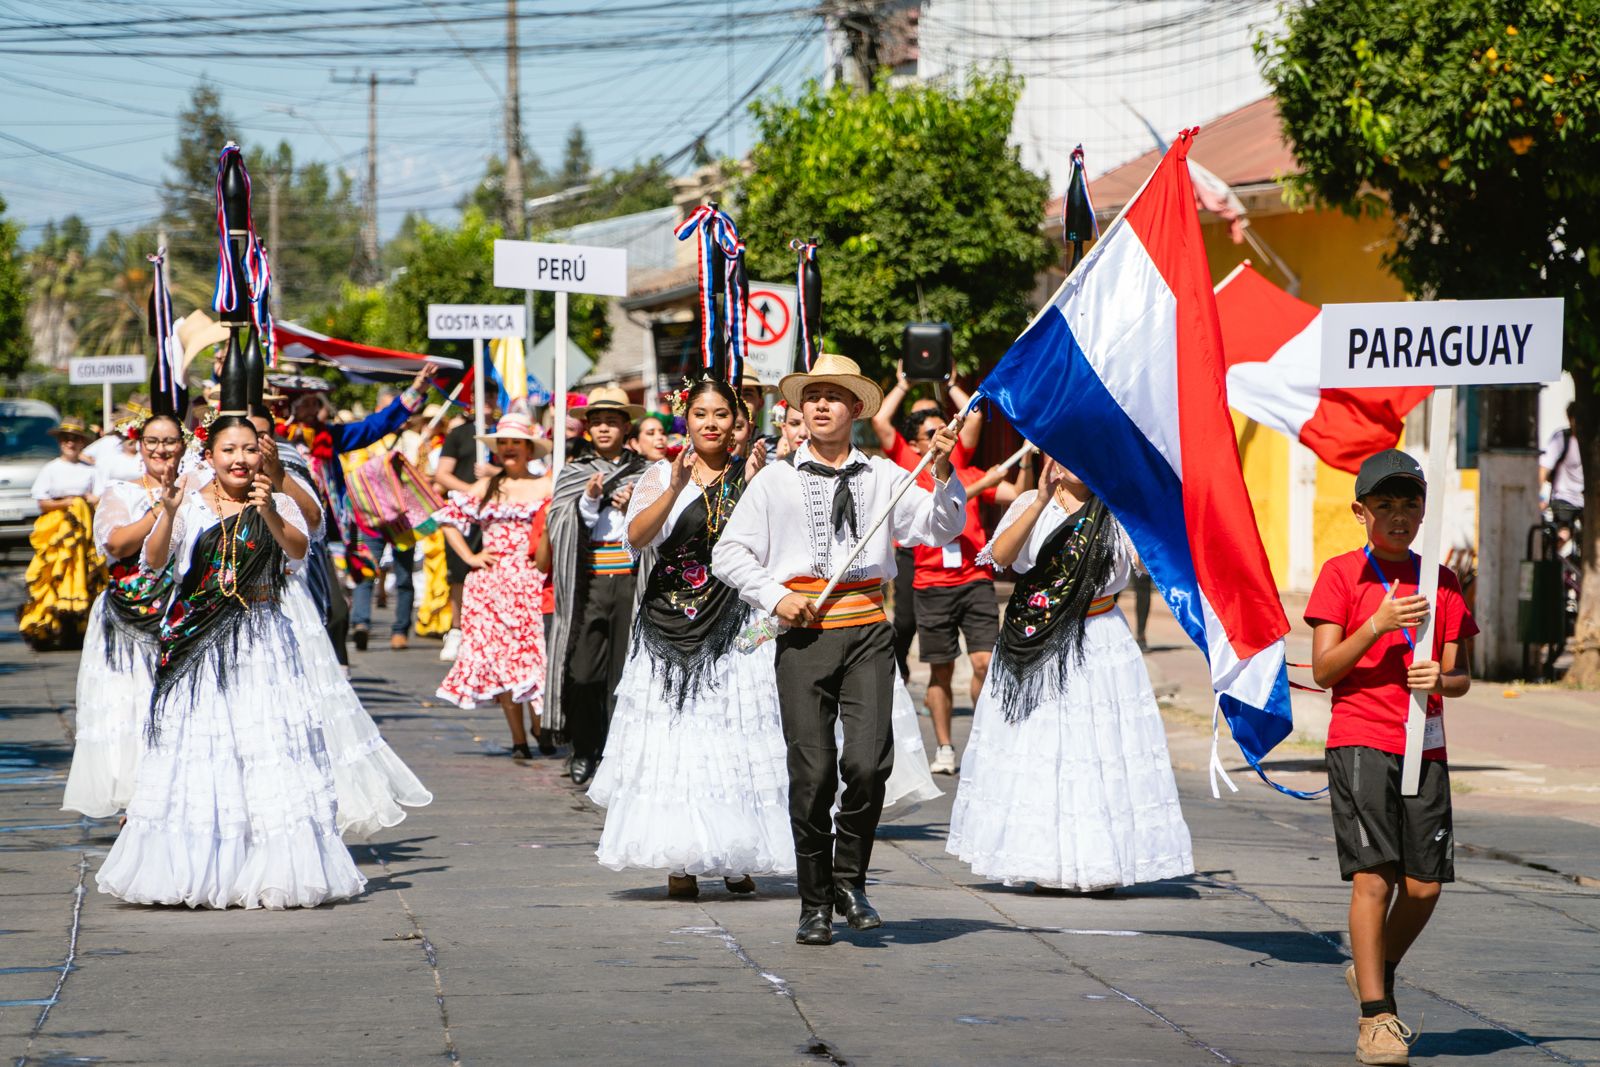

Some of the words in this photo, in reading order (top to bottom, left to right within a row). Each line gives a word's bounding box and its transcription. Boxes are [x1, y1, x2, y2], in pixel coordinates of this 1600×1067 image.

[538, 254, 586, 281] PERÚ
[435, 315, 479, 331] COSTA
[483, 315, 514, 331] RICA
[1348, 323, 1534, 369] PARAGUAY
[77, 362, 134, 378] COLOMBIA
